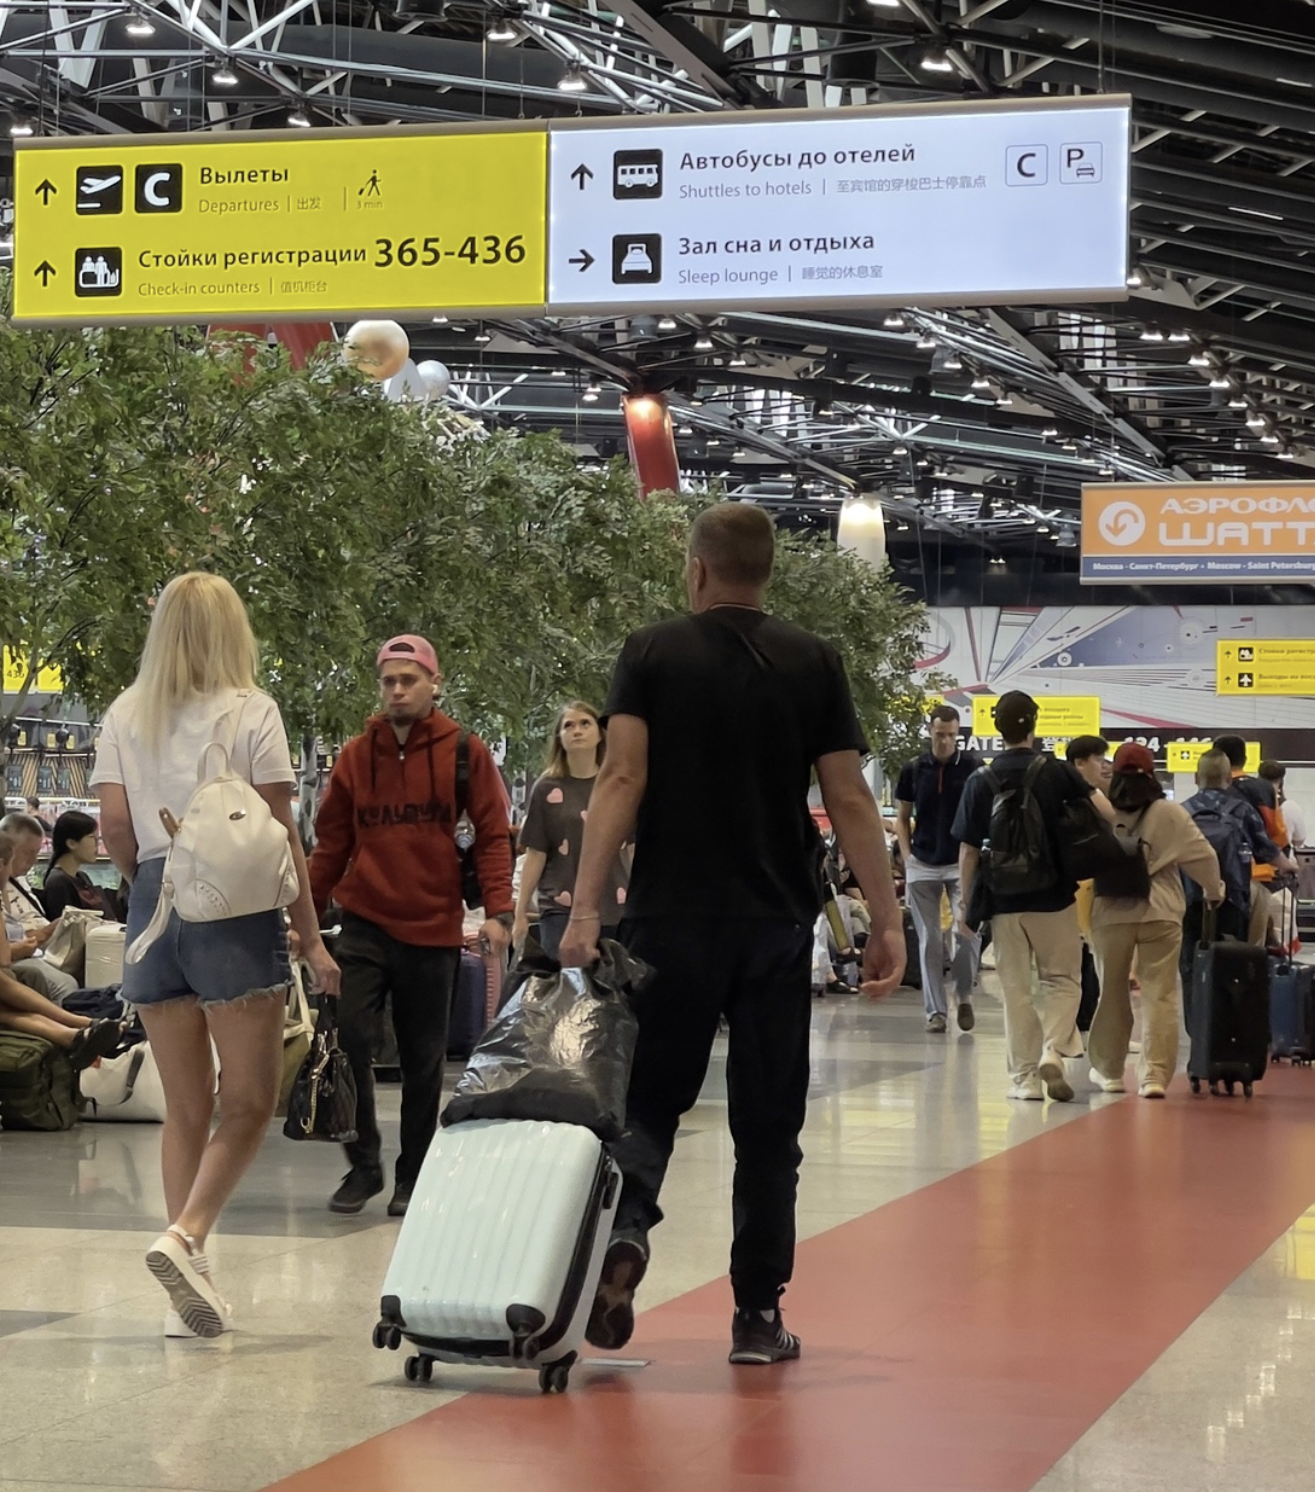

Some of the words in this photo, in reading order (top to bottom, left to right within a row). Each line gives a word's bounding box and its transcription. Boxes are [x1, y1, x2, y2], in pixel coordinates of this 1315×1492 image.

[679, 149, 792, 175] Автобусы
[798, 150, 828, 170] до
[833, 142, 916, 165] отелей
[1015, 152, 1036, 178] C
[199, 167, 289, 185] Вылеты
[143, 172, 171, 206] C
[679, 182, 740, 199] Shuttles
[745, 182, 761, 196] to
[765, 179, 812, 195] hotels
[198, 196, 280, 215] Departures
[296, 196, 322, 211] 出发
[374, 234, 527, 268] 365-436
[678, 236, 717, 256] Зал
[723, 236, 762, 253] сна
[768, 237, 782, 252] и
[788, 233, 875, 254] отдыха
[138, 249, 217, 270] Стойки
[223, 246, 366, 273] регистрации
[678, 268, 720, 286] Sleep
[724, 264, 778, 284] lounge
[802, 264, 883, 280] 睡觉的休息室
[138, 280, 198, 296] Check-in
[201, 279, 260, 295] counters
[1159, 522, 1315, 546] ШАТТ
[1093, 562, 1124, 571] Москва
[1207, 561, 1242, 570] Moscow
[1247, 561, 1270, 570] Saint
